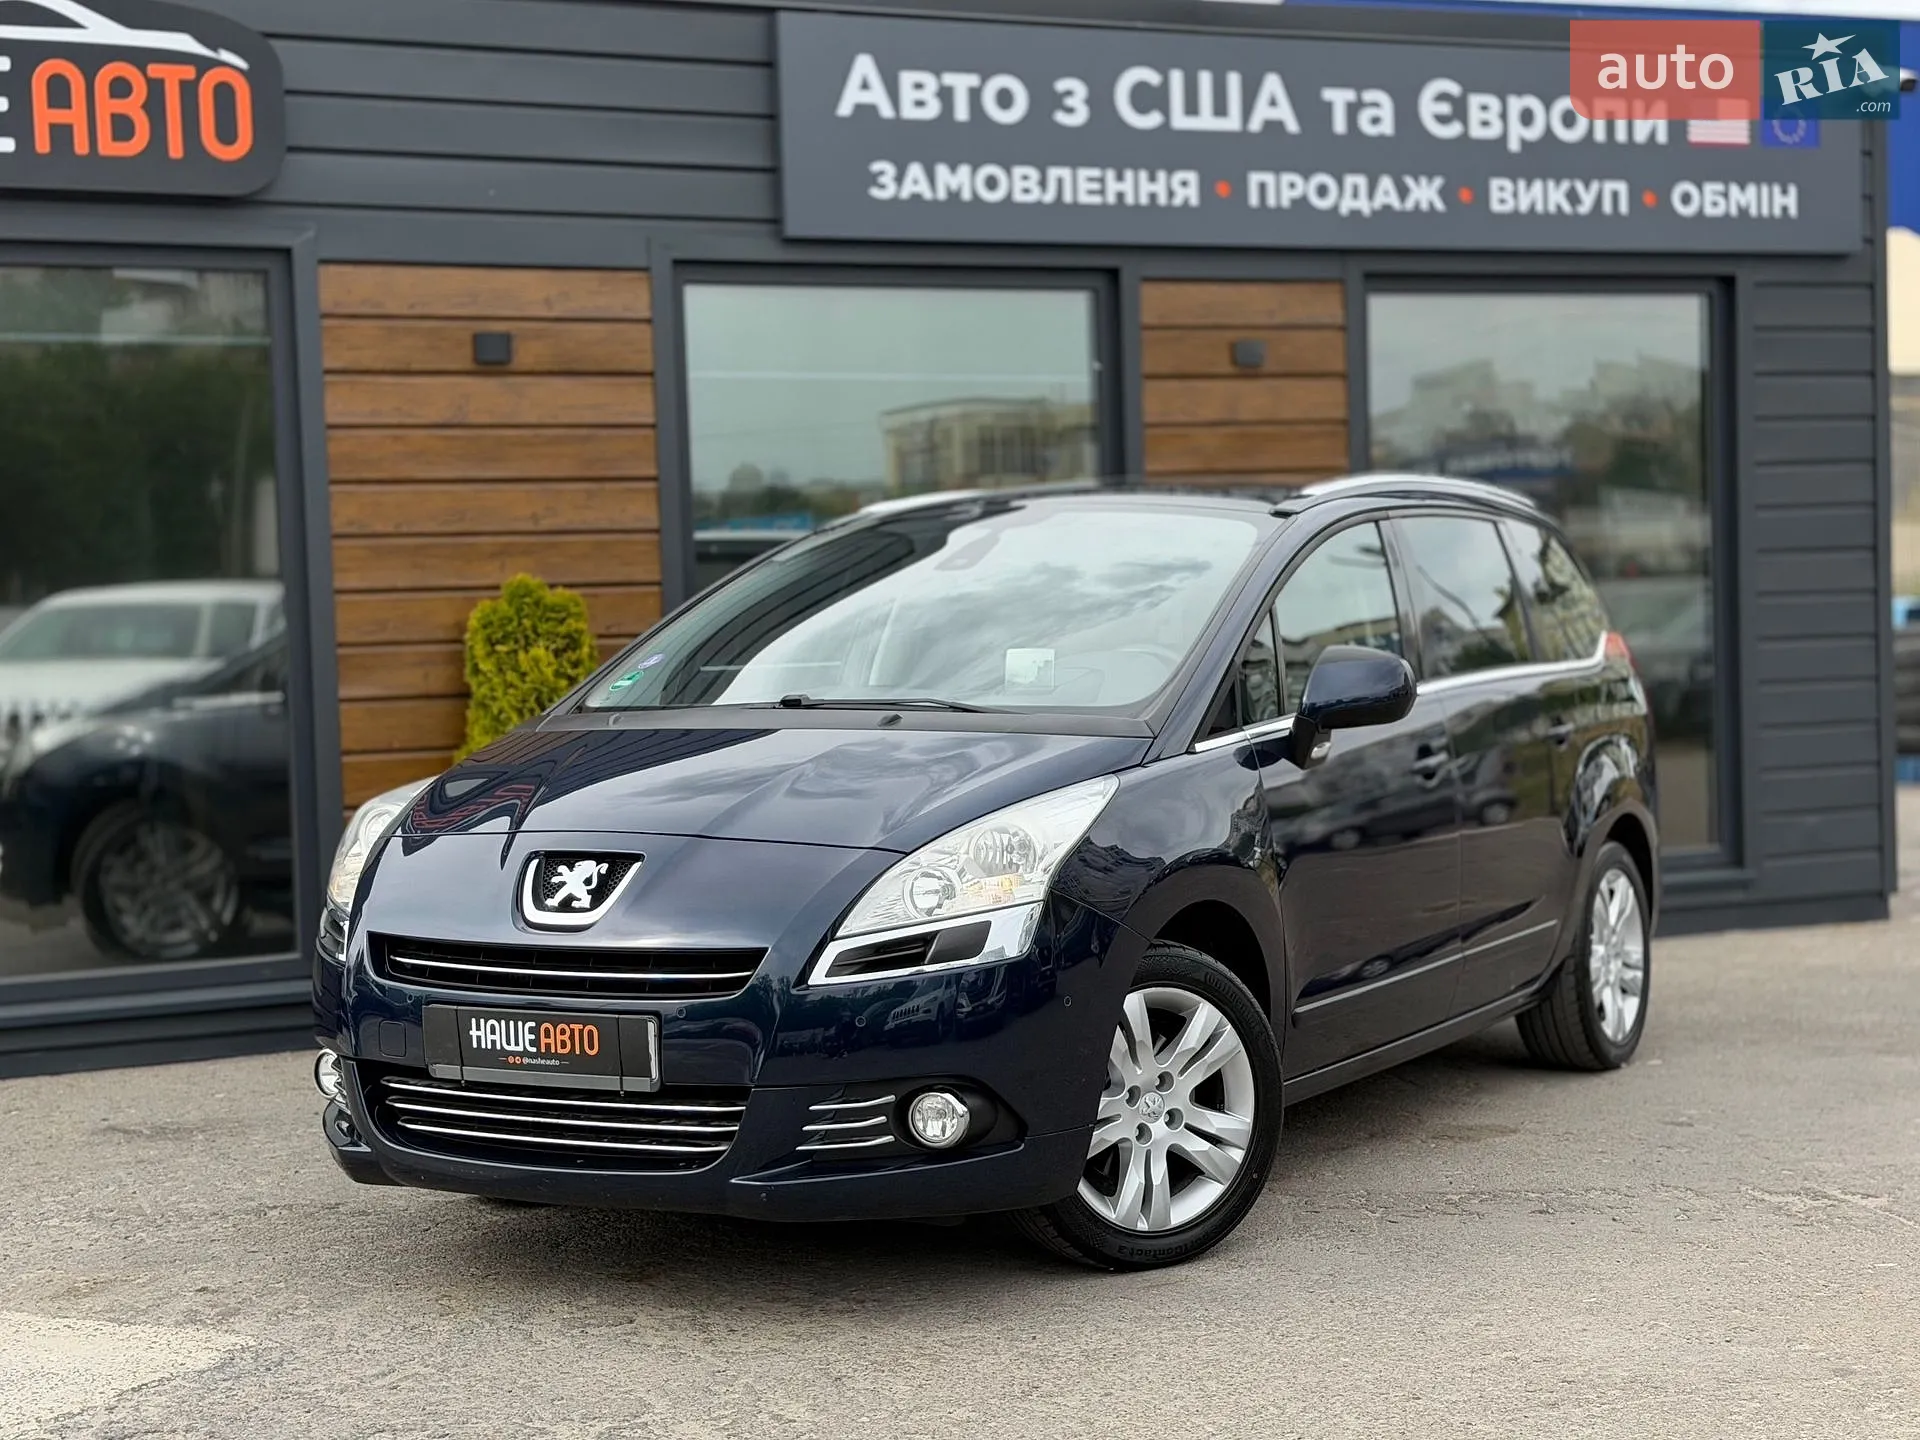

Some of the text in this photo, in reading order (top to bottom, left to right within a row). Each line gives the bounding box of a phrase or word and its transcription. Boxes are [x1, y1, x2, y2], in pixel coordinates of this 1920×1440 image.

[31, 58, 253, 162] АВТО
[835, 53, 1029, 125] Авто
[1053, 77, 1090, 127] з
[1113, 66, 1301, 134] США
[1321, 87, 1396, 137] та
[868, 160, 1799, 218] ЗАМОВЛЕННЯ ПРОДАЖ ВИКУП ОБМІН
[469, 1017, 600, 1057] НАШЕ АВТО
